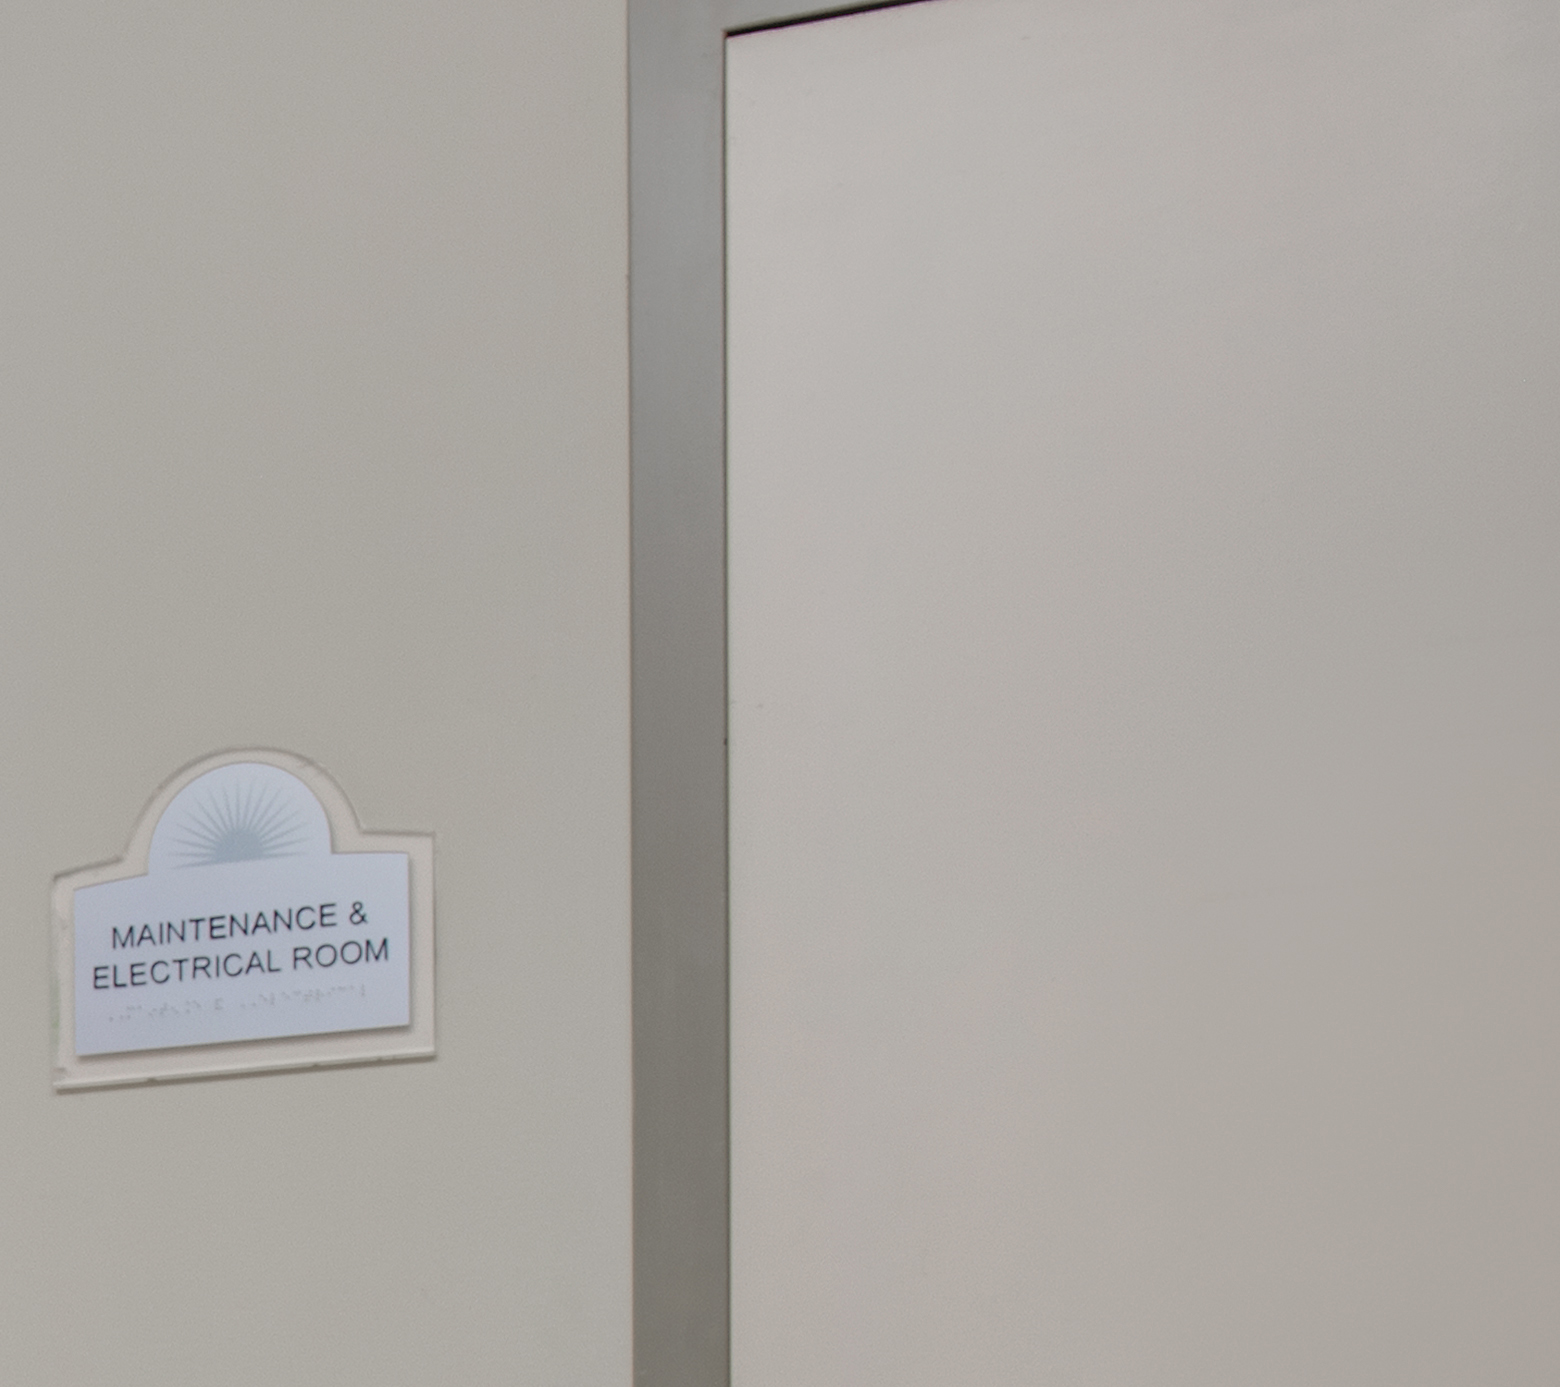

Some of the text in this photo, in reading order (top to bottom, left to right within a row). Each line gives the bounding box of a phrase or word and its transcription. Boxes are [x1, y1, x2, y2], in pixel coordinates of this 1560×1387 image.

[111, 900, 369, 950] MAINTENANCE &
[92, 937, 390, 991] ELECTRICAL ROOM
